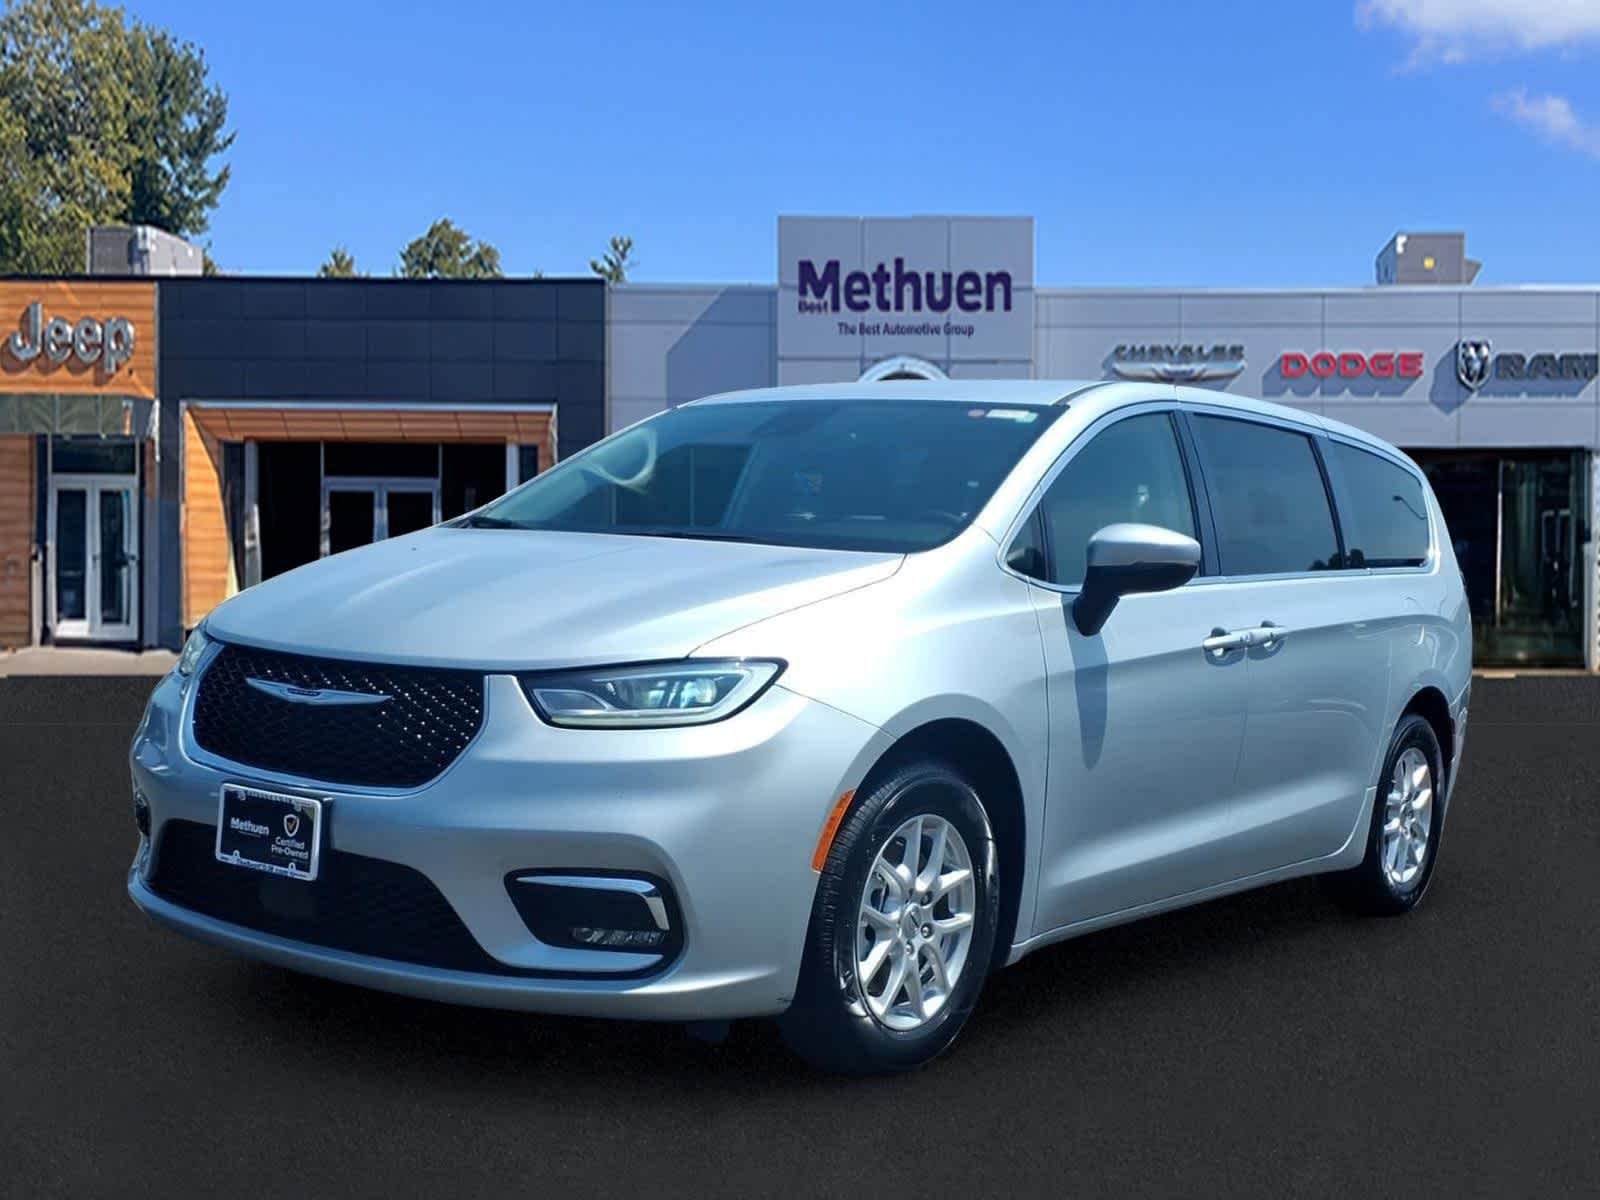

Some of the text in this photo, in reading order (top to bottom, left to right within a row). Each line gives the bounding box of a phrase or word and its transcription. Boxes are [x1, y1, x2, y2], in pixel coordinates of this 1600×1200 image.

[798, 257, 1012, 313] Methuen
[9, 302, 135, 374] Jeep
[838, 322, 974, 338] The Best Automotive Group
[1113, 344, 1245, 361] CHRYSLER
[1280, 352, 1424, 378] DODGE
[1496, 353, 1599, 379] RAM
[230, 817, 270, 836] Methuen
[271, 844, 309, 859] Pre-Owned
[275, 836, 305, 850] Certified
